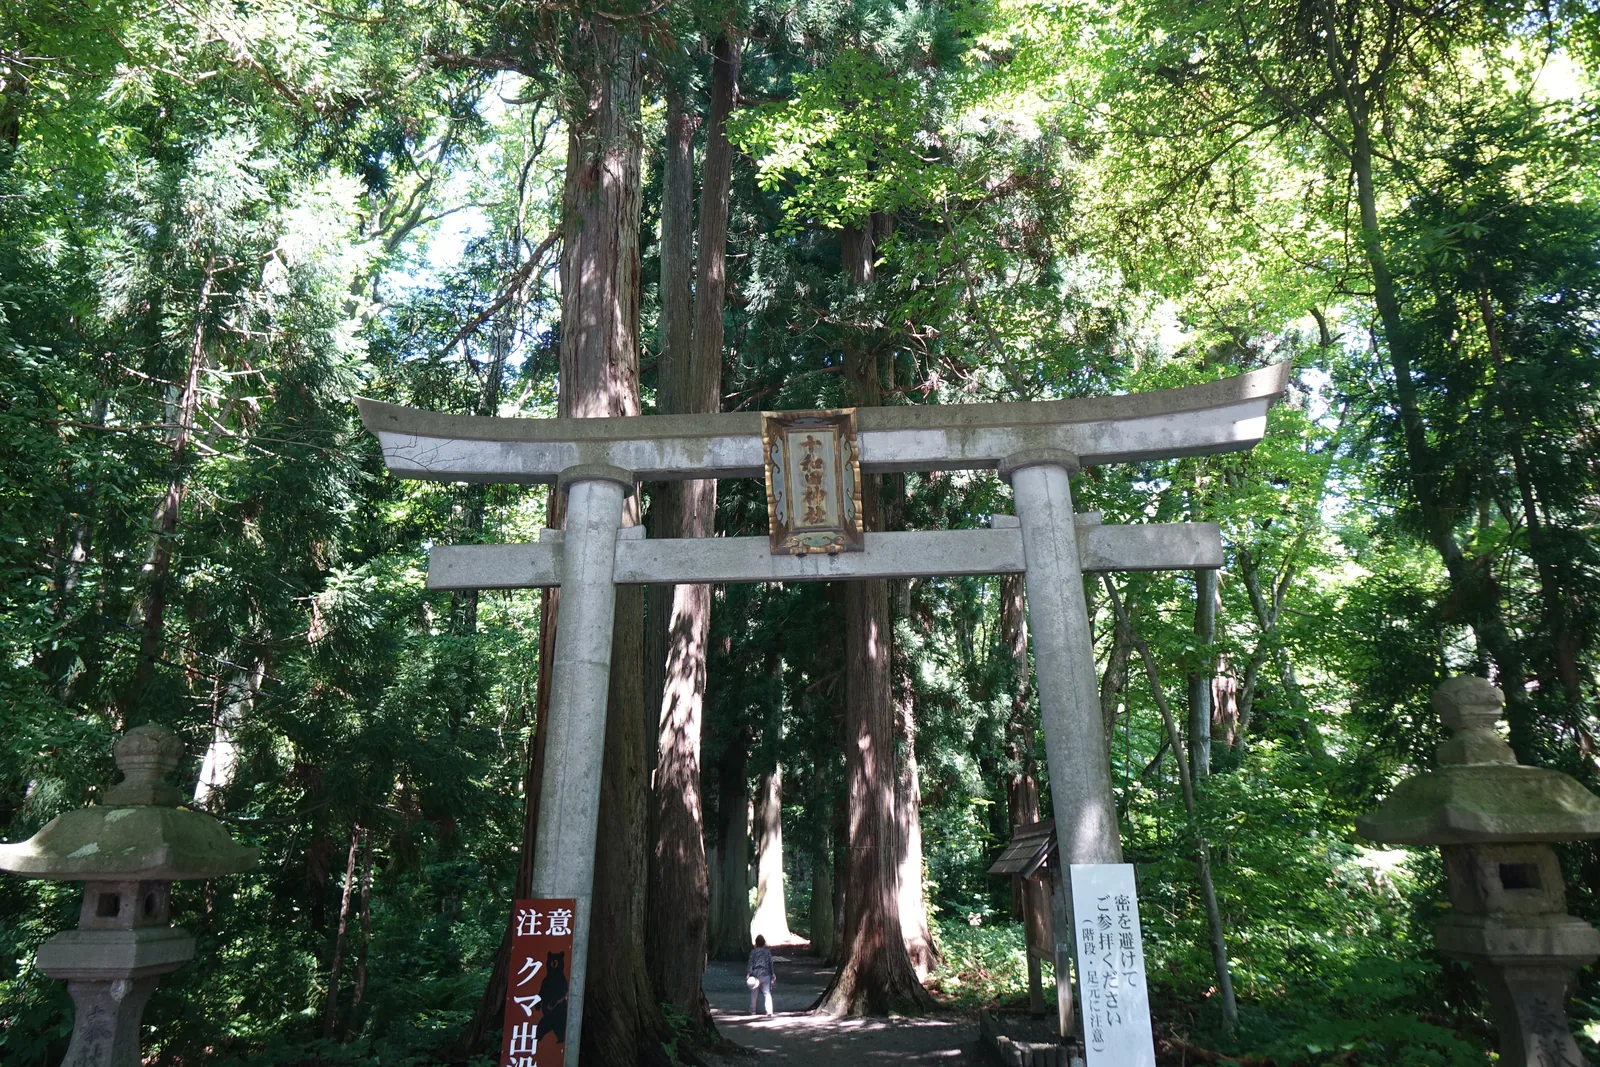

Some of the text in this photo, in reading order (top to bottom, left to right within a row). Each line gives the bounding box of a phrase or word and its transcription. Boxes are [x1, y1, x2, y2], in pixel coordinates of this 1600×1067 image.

[516, 908, 573, 937] 注意
[1096, 893, 1122, 1027] ご参拝ください
[1114, 893, 1139, 988] 密を避けて
